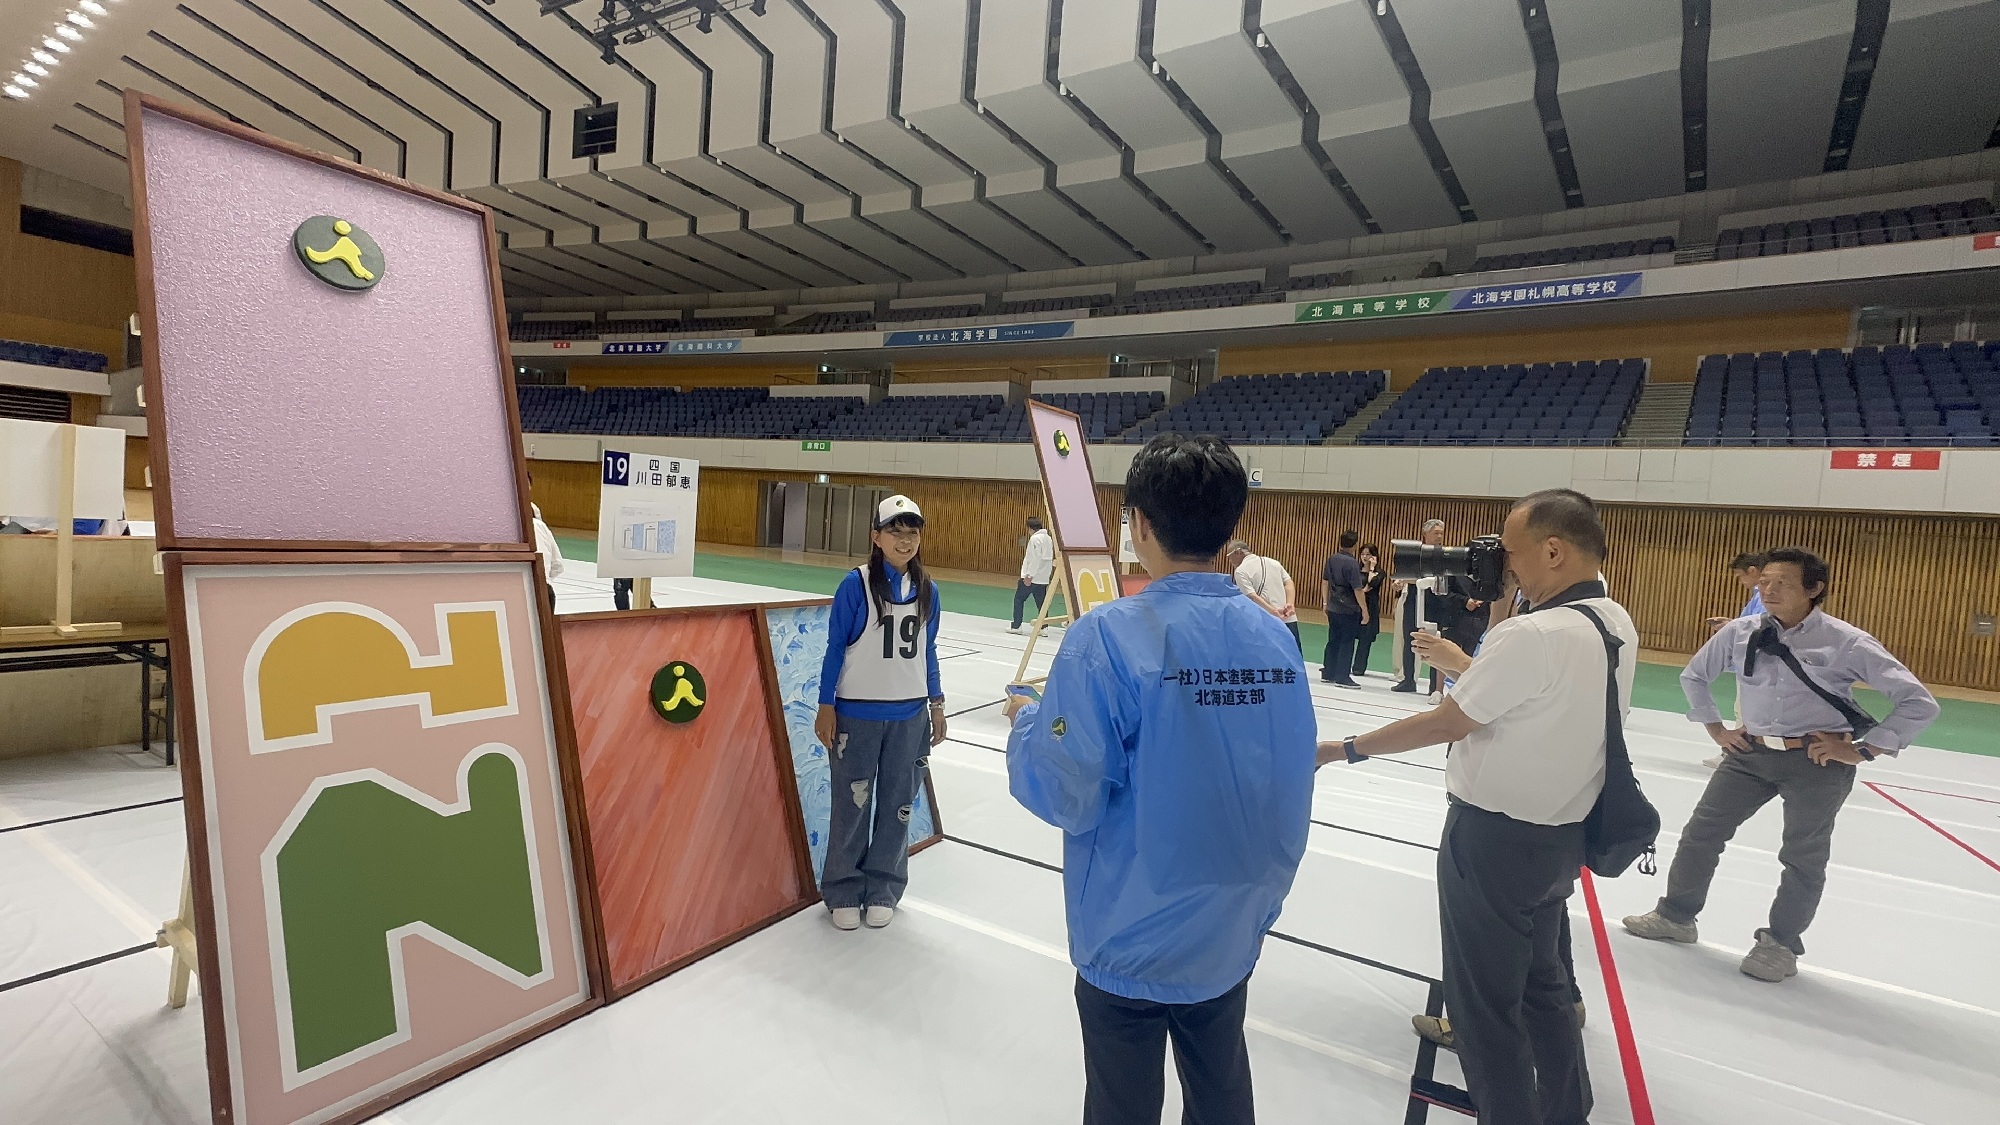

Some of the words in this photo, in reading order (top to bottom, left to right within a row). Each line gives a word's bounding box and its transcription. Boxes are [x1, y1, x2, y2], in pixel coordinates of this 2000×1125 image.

[1472, 280, 1617, 304] 北海学園札幌高等学校
[1311, 297, 1430, 317] 北海高等学校
[606, 456, 628, 480] 19
[649, 459, 680, 473] 四国
[1857, 453, 1912, 467] 禁煙
[636, 471, 691, 489] 川田郁恵
[1251, 470, 1260, 482] C
[880, 614, 920, 660] 19
[1194, 689, 1266, 706] 北海道支部
